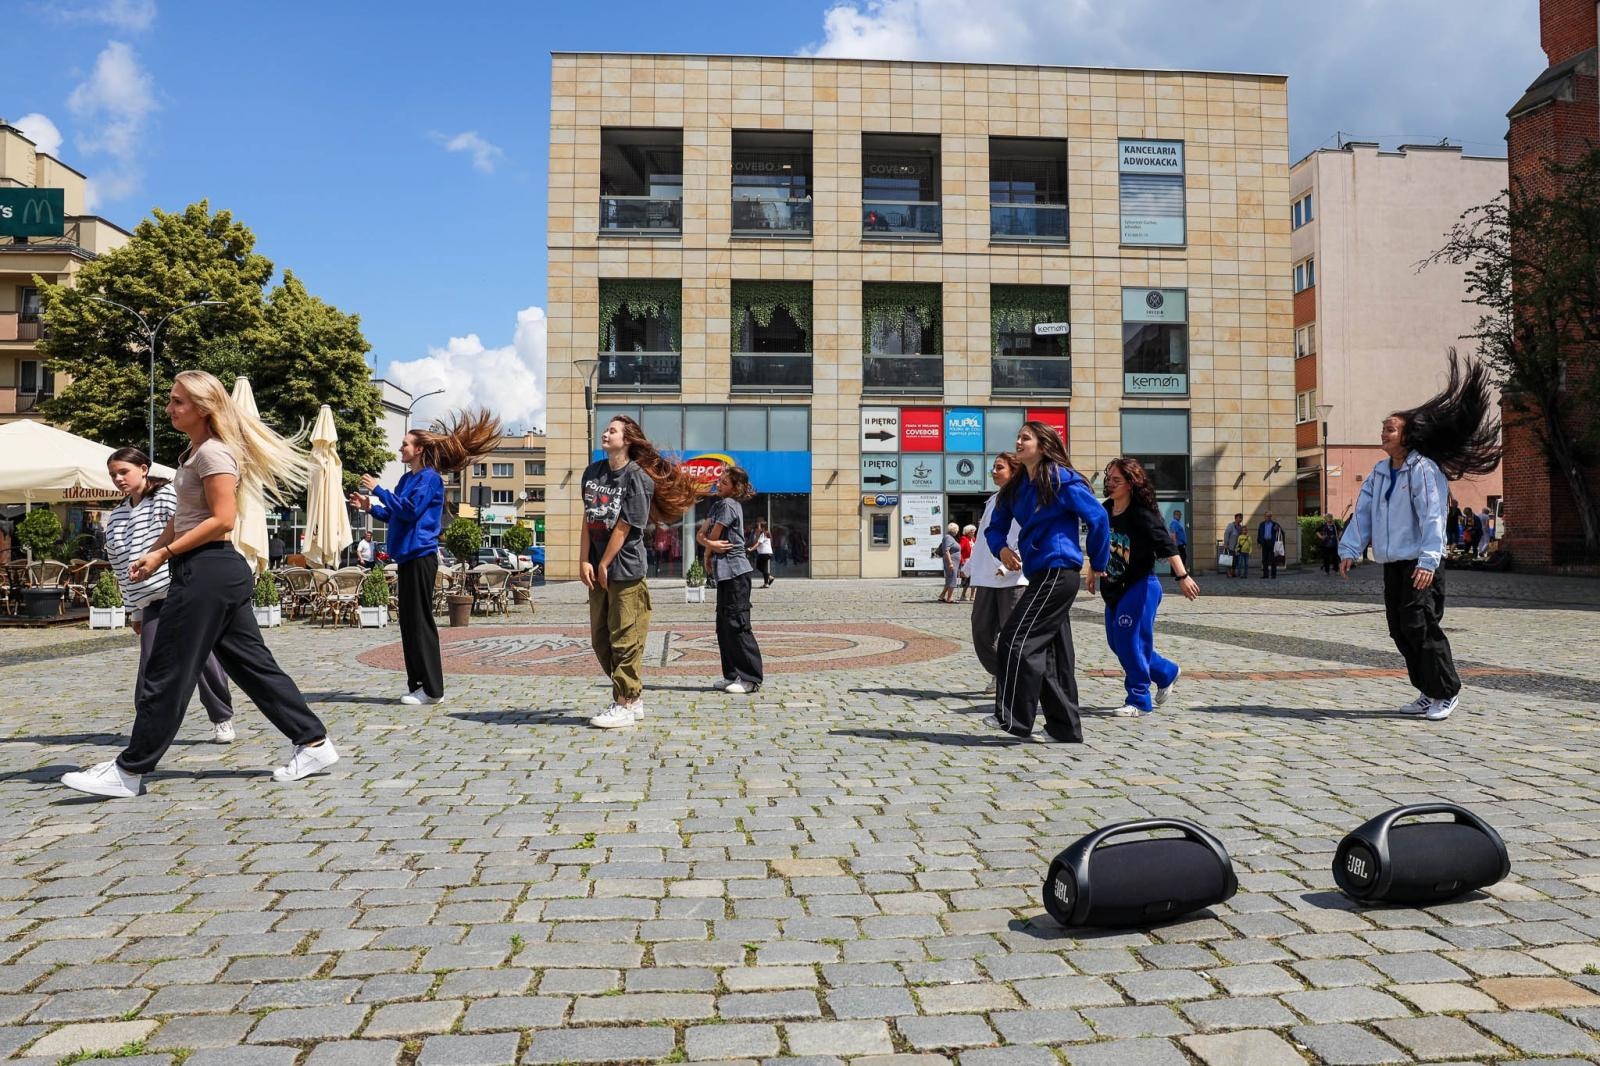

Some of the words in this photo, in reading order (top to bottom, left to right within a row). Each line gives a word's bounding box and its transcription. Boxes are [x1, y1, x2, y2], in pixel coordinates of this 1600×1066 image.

[1124, 145, 1177, 156] KANCELARIA
[1123, 157, 1178, 167] ADWOKACKA
[871, 418, 897, 426] PIĘTRO
[868, 461, 898, 469] PIĘTRO
[1347, 854, 1368, 879] JBL
[1054, 878, 1069, 904] JBL
